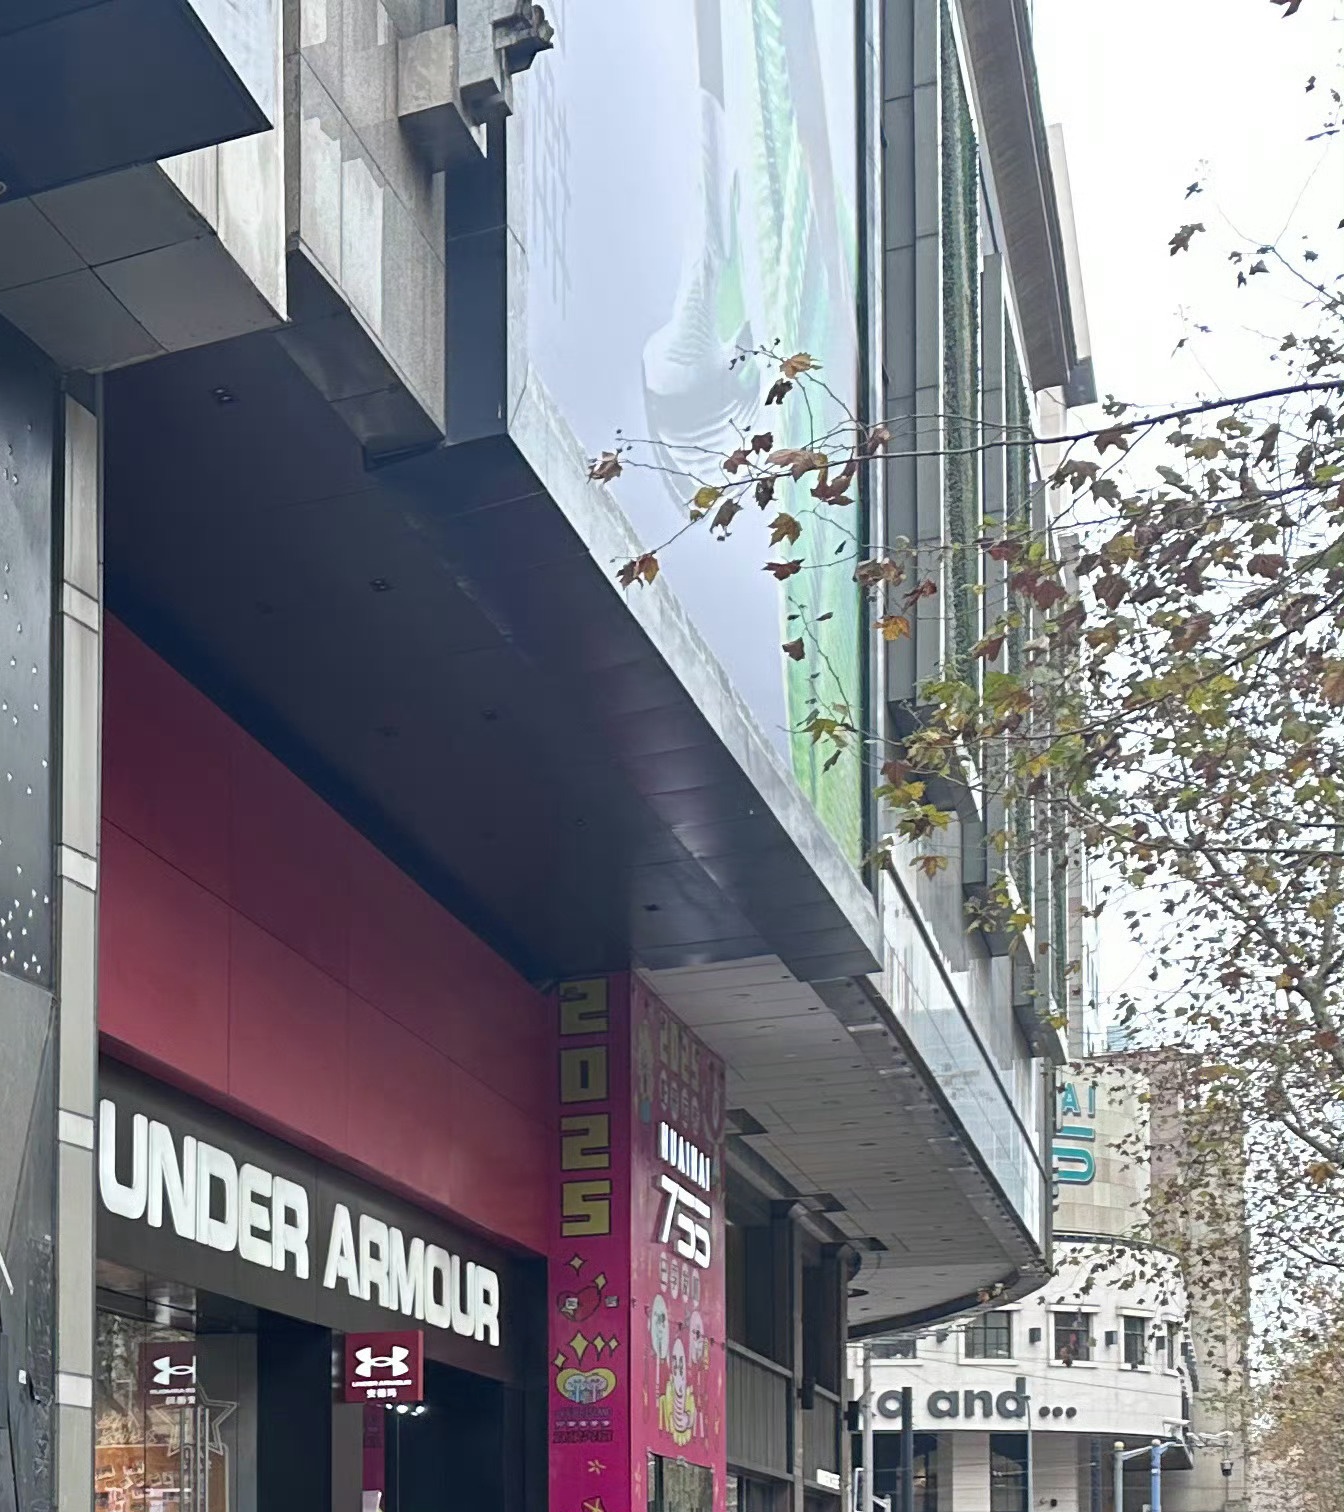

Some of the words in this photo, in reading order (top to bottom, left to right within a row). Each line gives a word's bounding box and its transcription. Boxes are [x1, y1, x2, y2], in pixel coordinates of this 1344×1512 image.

[660, 1121, 711, 1191] HUAIHAI
[99, 1098, 310, 1280] UNDER
[323, 1203, 500, 1347] ARMOUR
[927, 1377, 1027, 1419] and
